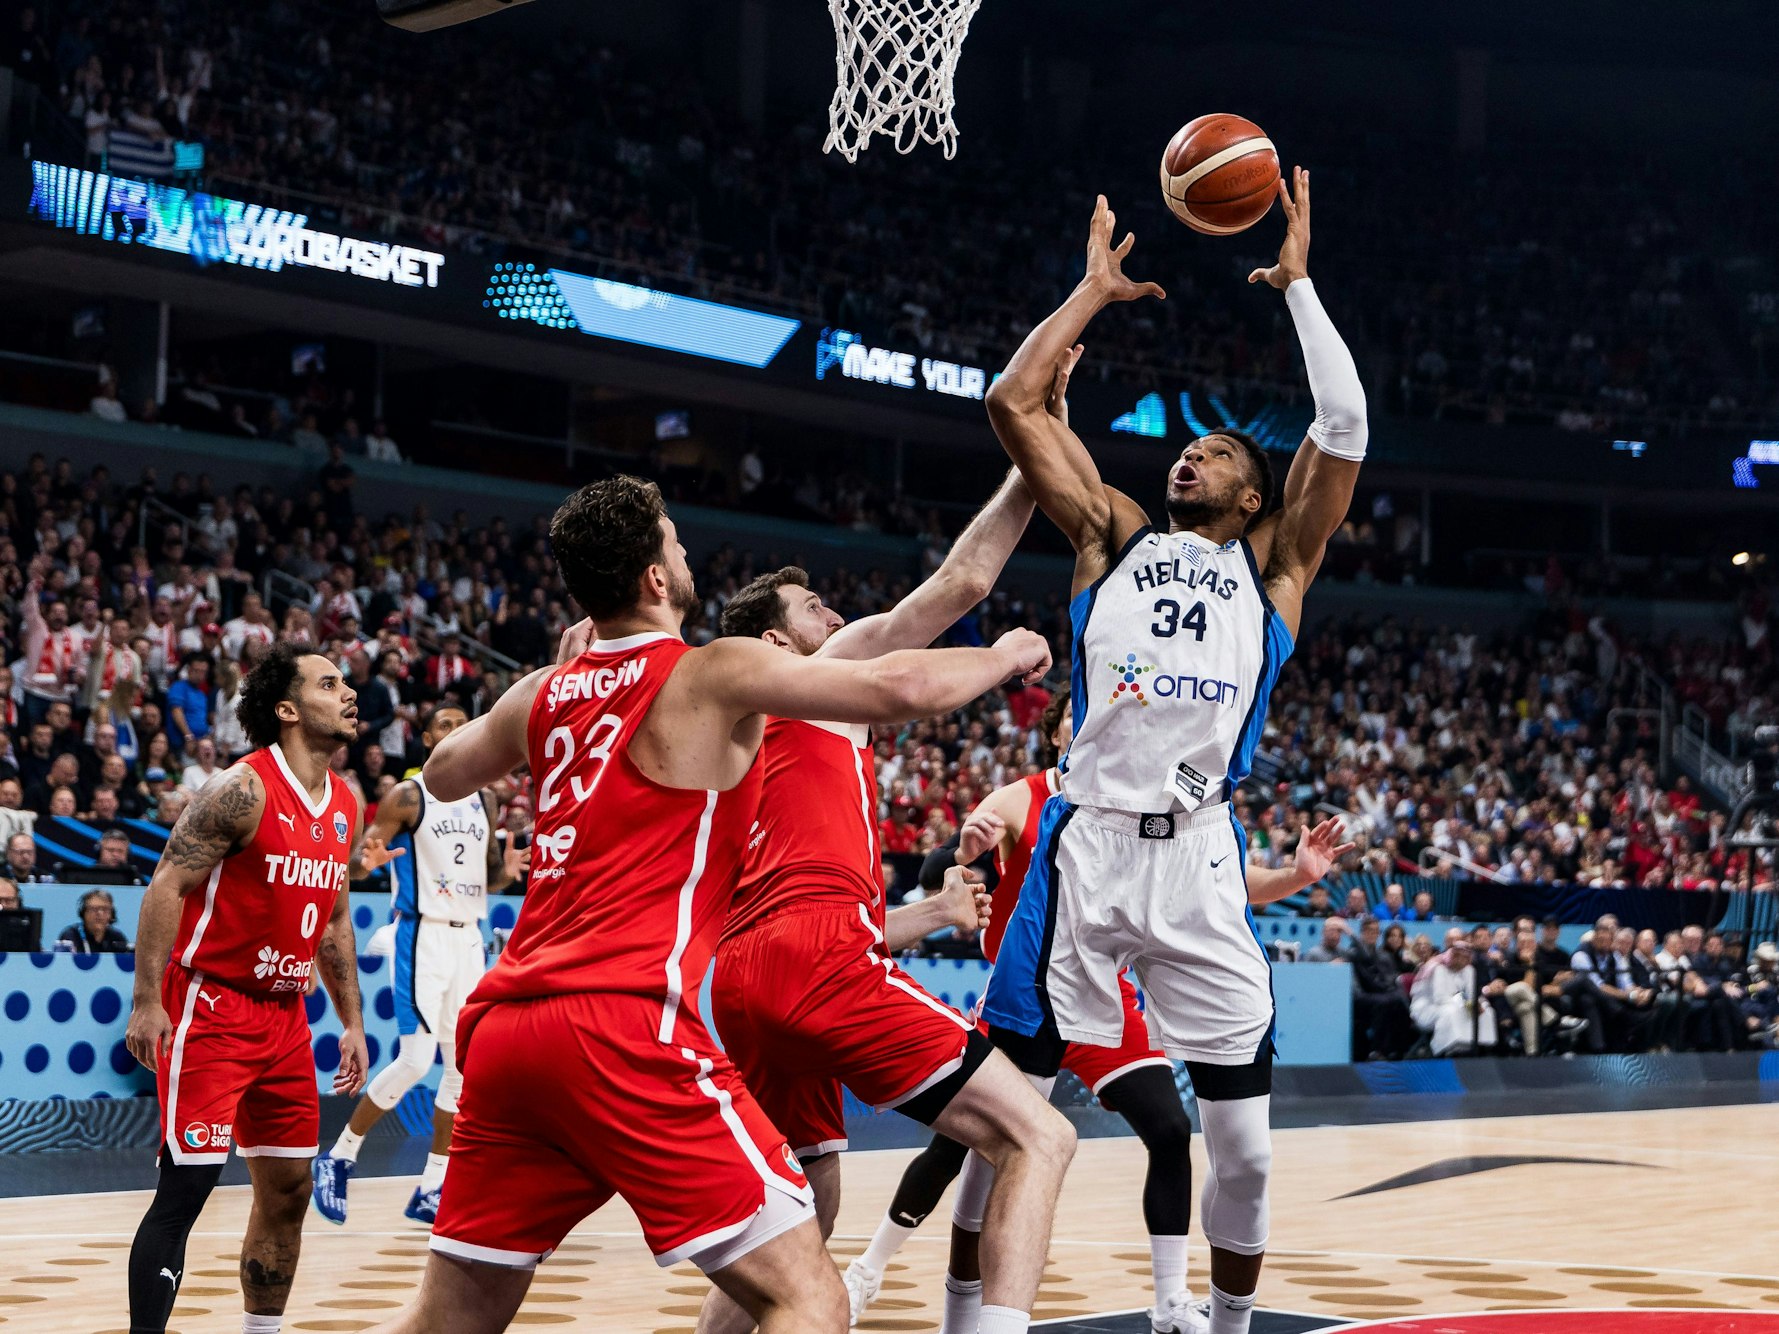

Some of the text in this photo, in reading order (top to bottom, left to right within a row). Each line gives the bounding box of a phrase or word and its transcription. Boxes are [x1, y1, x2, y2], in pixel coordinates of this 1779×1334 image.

[1222, 163, 1270, 190] molten
[842, 343, 986, 400] MAKE YOUR
[1133, 558, 1239, 601] HELLAS
[1151, 598, 1208, 642] 34
[538, 713, 623, 813] 23
[430, 818, 484, 842] HELLAS
[453, 842, 465, 865] 2
[300, 902, 319, 939] 0
[278, 954, 314, 978] Gara
